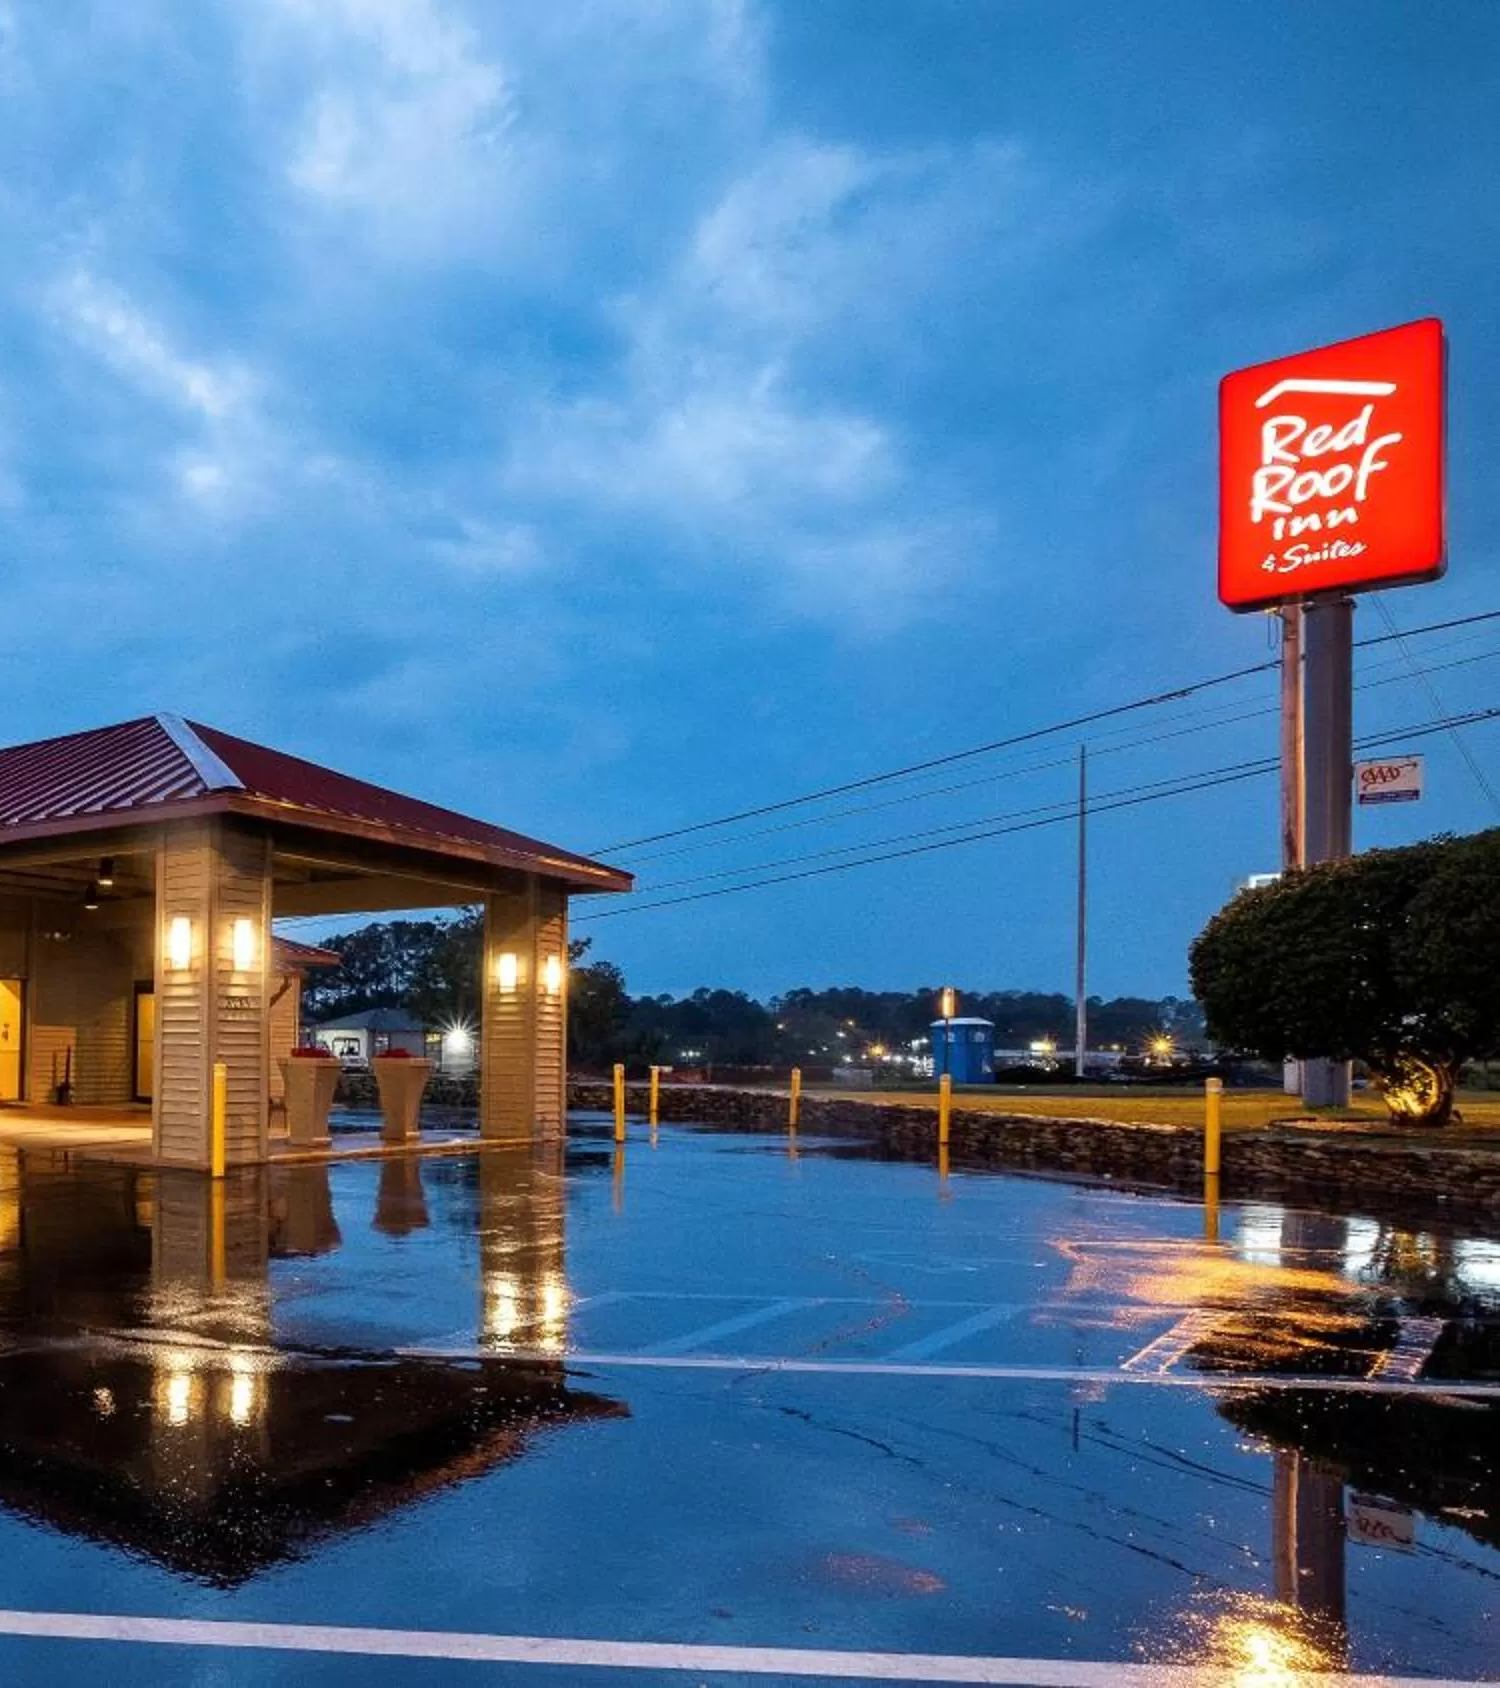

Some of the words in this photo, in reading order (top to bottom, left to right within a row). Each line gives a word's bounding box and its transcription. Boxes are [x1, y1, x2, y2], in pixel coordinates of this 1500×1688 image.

[1262, 404, 1374, 465] Red
[1250, 433, 1403, 523] Roof
[1278, 540, 1367, 573] Suites
